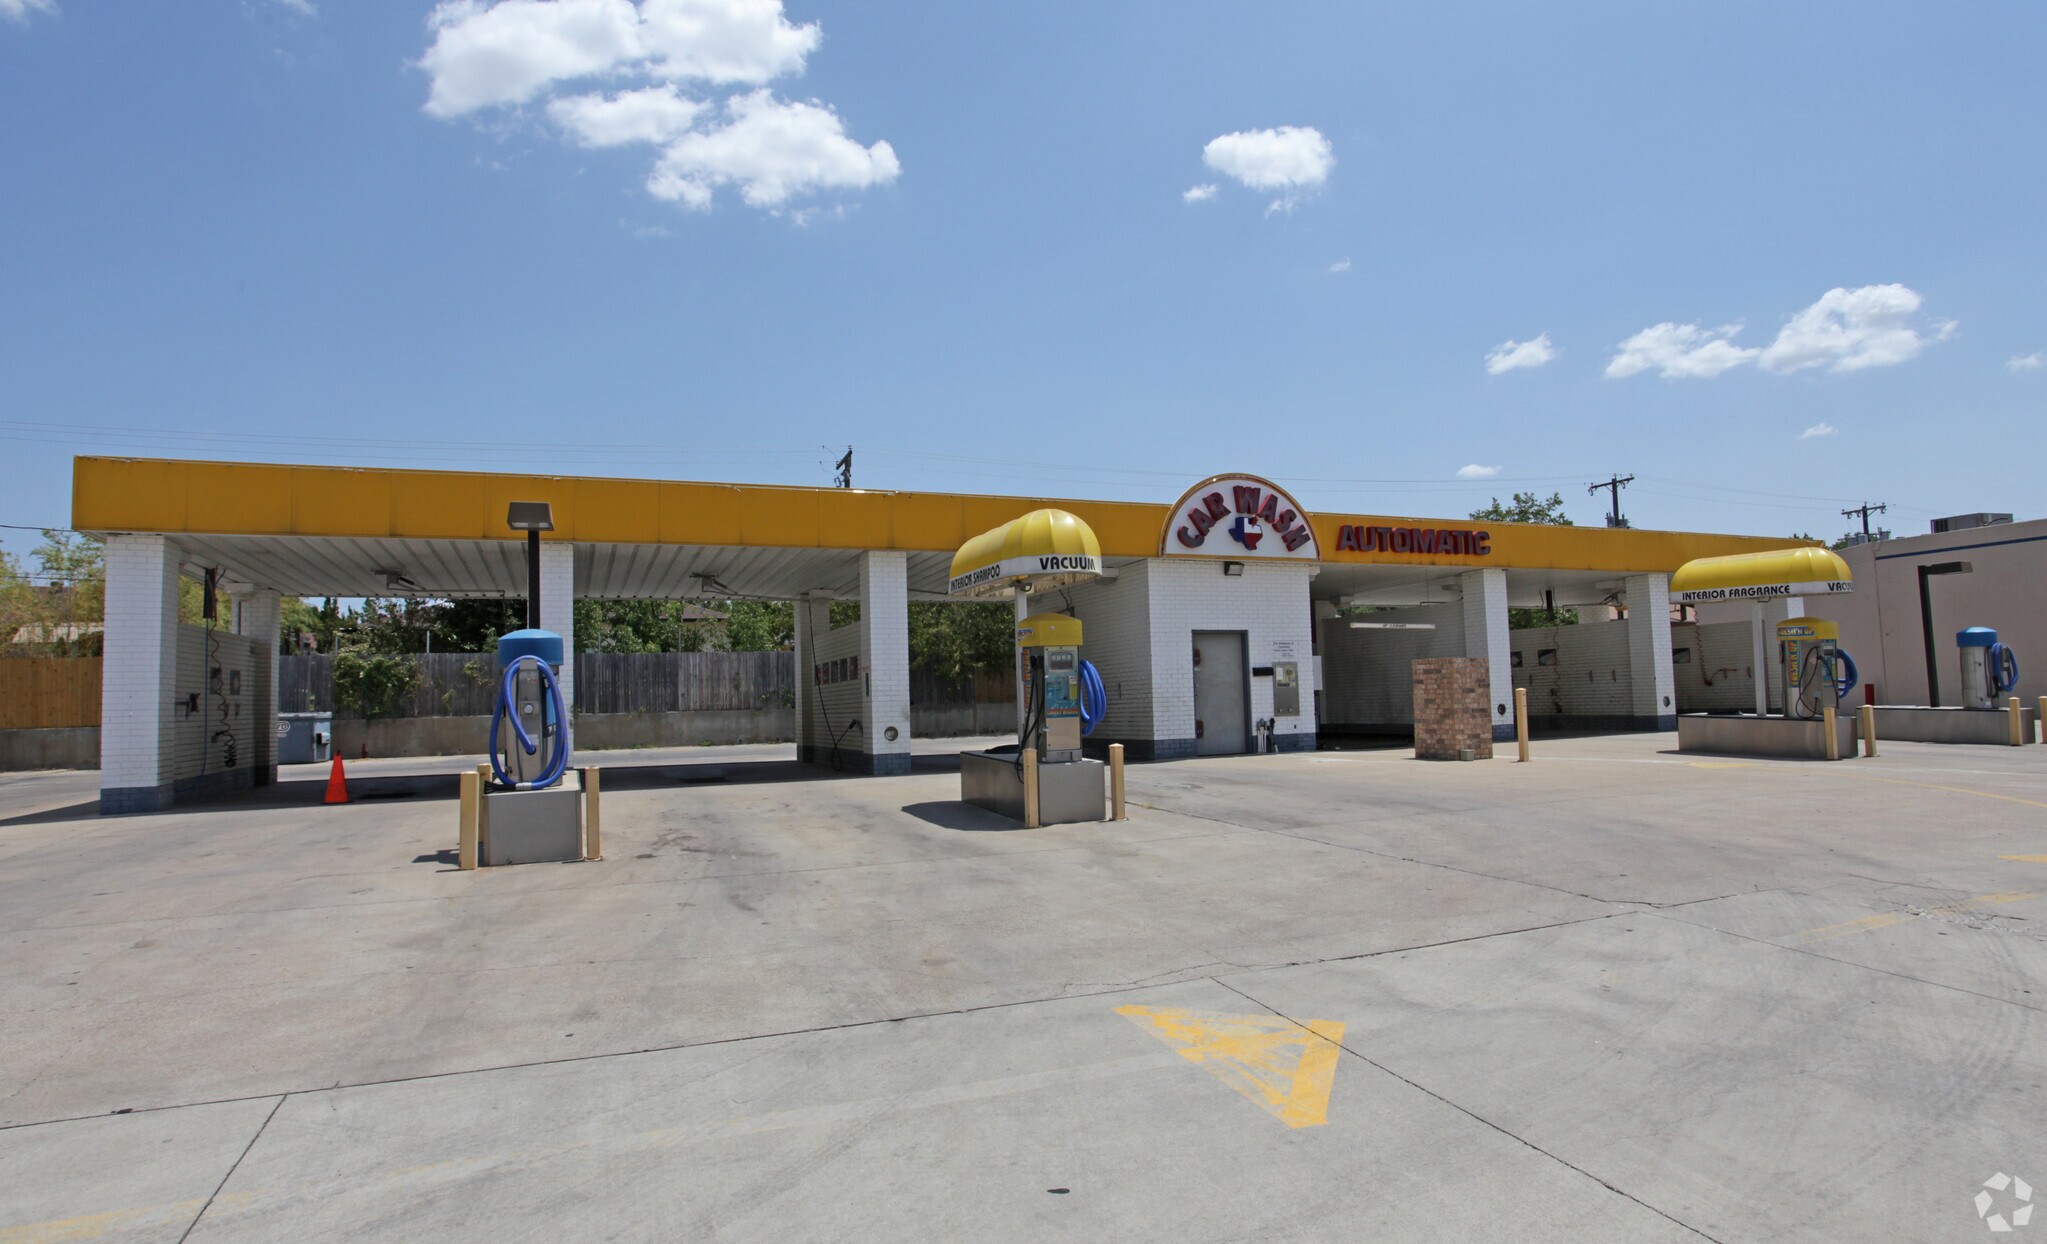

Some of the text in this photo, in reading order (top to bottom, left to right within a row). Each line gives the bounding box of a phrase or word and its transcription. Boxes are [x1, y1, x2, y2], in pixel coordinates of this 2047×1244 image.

[1177, 485, 1311, 552] CAR WASH
[1336, 524, 1492, 556] AUTOMATIC
[1039, 556, 1096, 571] VACUUM
[950, 564, 1001, 592] INTERIOR SHAMPOO
[1682, 584, 1791, 601] INTERIOR FRAGRANCE
